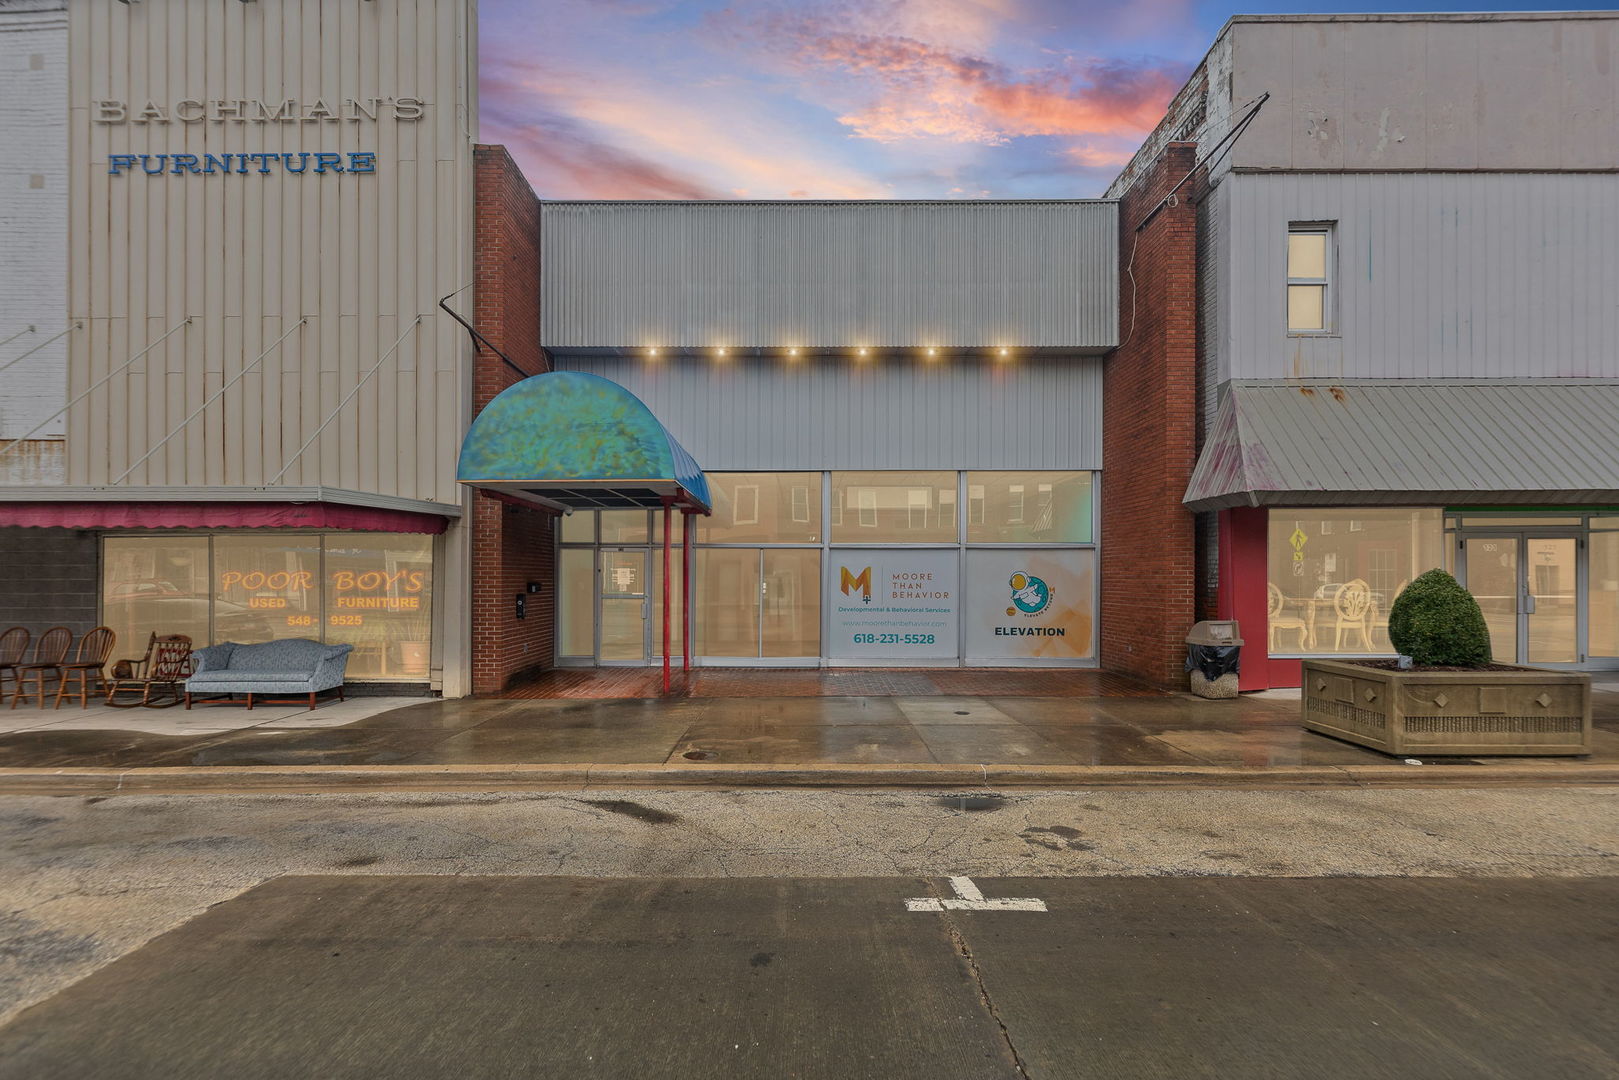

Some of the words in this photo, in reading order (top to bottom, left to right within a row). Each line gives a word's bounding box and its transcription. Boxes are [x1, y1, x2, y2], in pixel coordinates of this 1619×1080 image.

[92, 96, 425, 122] BACHMAN'S
[108, 151, 376, 174] FURNITURE
[222, 570, 314, 592] POOR
[333, 570, 424, 592] BOY'S
[892, 591, 950, 599] BEHAVIOR
[250, 598, 286, 608] USED
[338, 597, 419, 608] FURNITURE
[838, 606, 884, 614] Developmental
[330, 615, 363, 626] 9525
[994, 627, 1065, 636] ELEVATION
[853, 633, 935, 644] 618-231-5528
